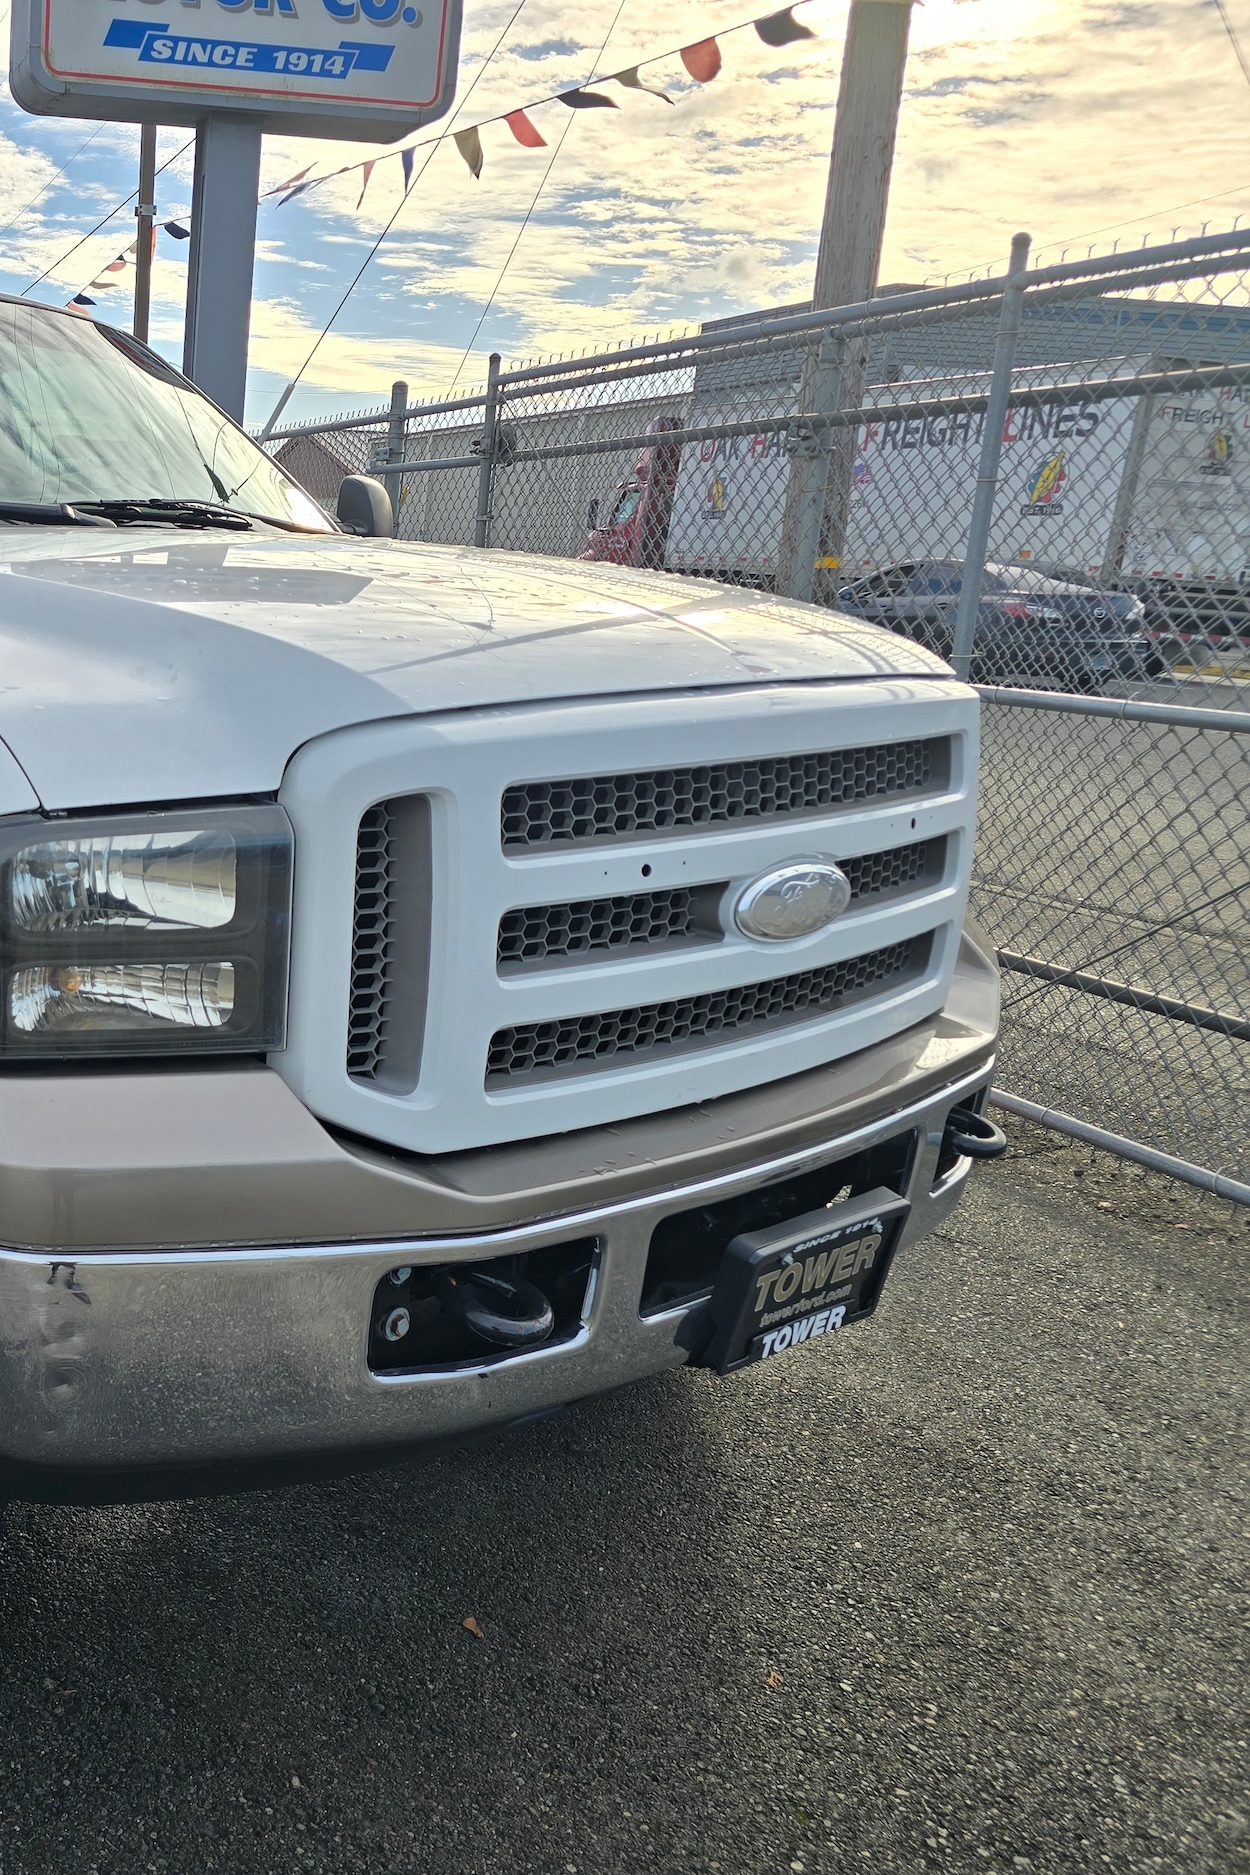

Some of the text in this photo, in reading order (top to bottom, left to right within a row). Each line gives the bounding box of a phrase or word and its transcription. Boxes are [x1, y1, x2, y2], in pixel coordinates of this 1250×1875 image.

[150, 39, 344, 75] SINCE 1914
[1002, 402, 1099, 442] LINES
[793, 1230, 842, 1253] SINCE
[754, 1233, 883, 1313] TOWER
[761, 1305, 847, 1359] TOWER
